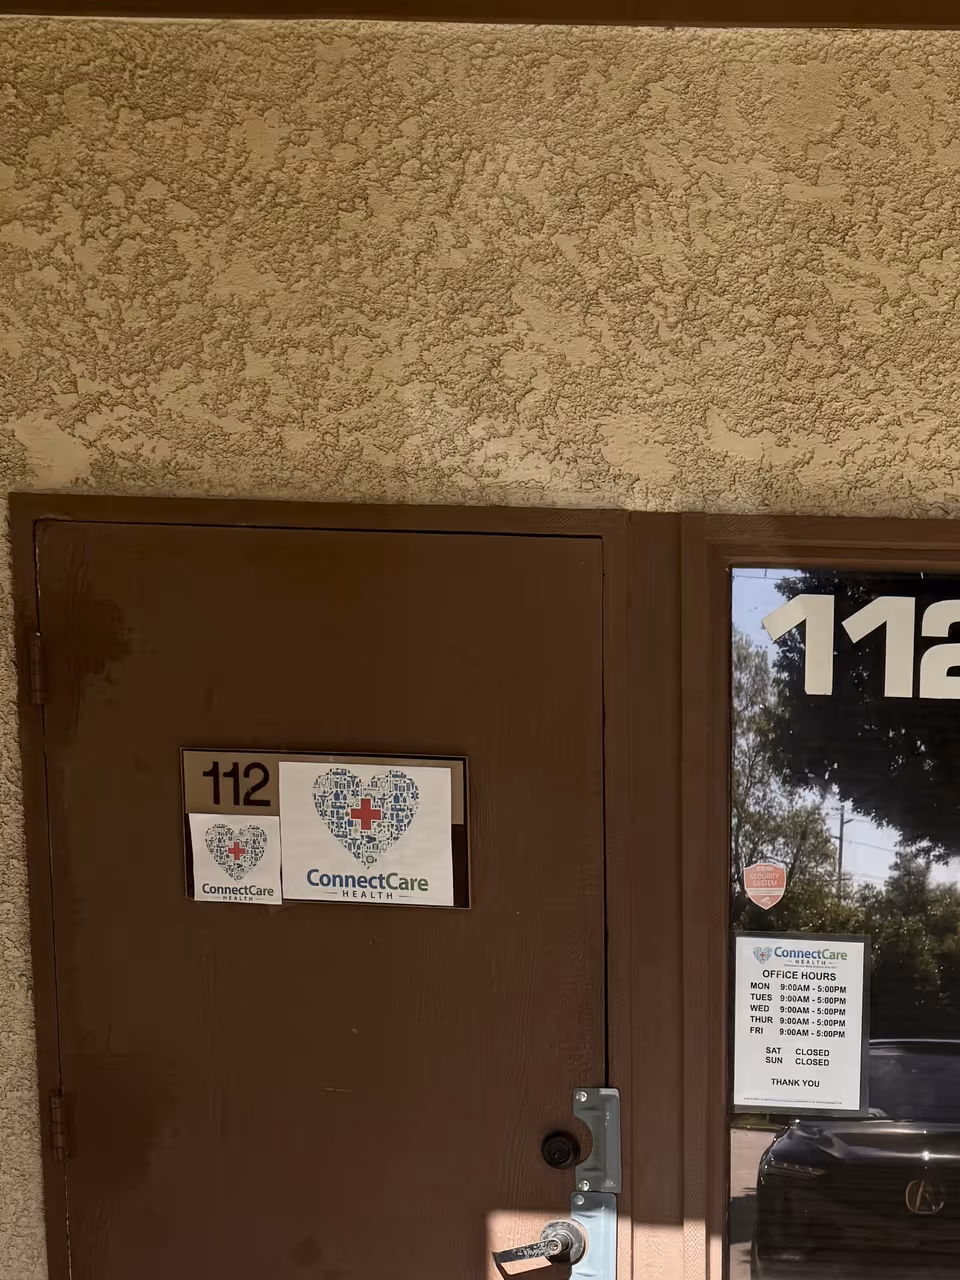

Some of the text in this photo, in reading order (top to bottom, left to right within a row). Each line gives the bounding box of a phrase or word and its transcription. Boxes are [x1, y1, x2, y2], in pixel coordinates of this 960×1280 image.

[203, 761, 271, 806] 112
[306, 868, 429, 892] ConnectCare
[202, 883, 274, 897] ConnectCare
[342, 890, 393, 899] HEALTH
[773, 946, 848, 960] ConnectCare
[762, 969, 837, 981] OFFICE HOURS
[750, 982, 770, 990] MON
[780, 984, 810, 992] 9:00AM
[817, 985, 847, 993] 5:00PM
[750, 993, 773, 1001] TUES
[780, 995, 810, 1003] 9:00AM
[817, 997, 847, 1005] 5:00PM
[750, 1004, 770, 1012] WED
[780, 1006, 810, 1014] 9:00AM
[817, 1008, 846, 1016] 5:00PM
[750, 1016, 773, 1024] THUR
[780, 1017, 809, 1025] 9:00AM
[817, 1019, 846, 1027] 5:00PM
[780, 1028, 809, 1036] 9:00AM
[816, 1030, 845, 1038] 5:00PM
[795, 1048, 830, 1057] CLOSED
[795, 1058, 830, 1066] CLOSED
[771, 1078, 820, 1088] THANK YOU
